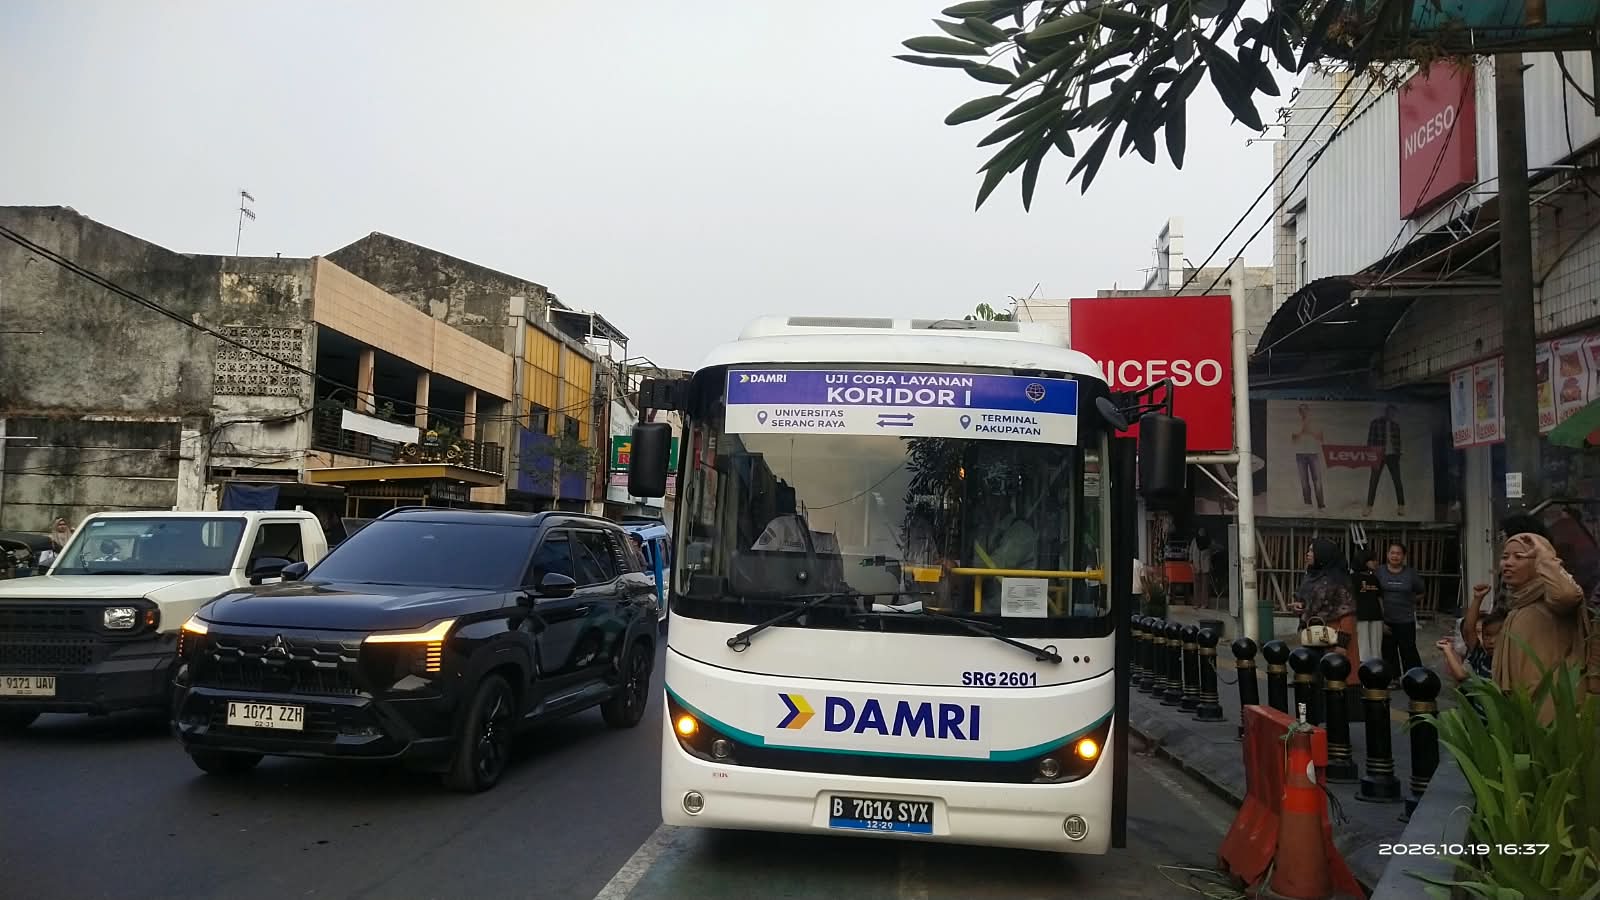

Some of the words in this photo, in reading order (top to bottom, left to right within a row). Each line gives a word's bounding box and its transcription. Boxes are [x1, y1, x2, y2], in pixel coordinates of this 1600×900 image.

[1405, 104, 1454, 160] NICESO
[750, 374, 787, 383] DAMRI
[1097, 359, 1222, 387] ICESO
[825, 374, 848, 384] UJI
[852, 375, 896, 385] COBA
[901, 376, 973, 387] LAYANAN
[827, 387, 955, 405] KORIDOR
[965, 390, 971, 406] I
[775, 409, 844, 417] UNIVERSITAS
[981, 414, 1038, 424] TERMINAL
[818, 420, 846, 428] RAYA
[975, 425, 1041, 435] PAKUPATAN
[7, 677, 30, 689] 9171
[36, 676, 54, 689] UAV
[962, 671, 996, 686] SRG
[999, 672, 1037, 687] 2601
[229, 704, 236, 718] A
[243, 704, 273, 721] 1071
[280, 707, 302, 722] ZZH
[824, 696, 980, 740] DAMRI
[833, 798, 843, 817] B
[853, 799, 893, 821] 7016
[898, 802, 928, 823] SYX
